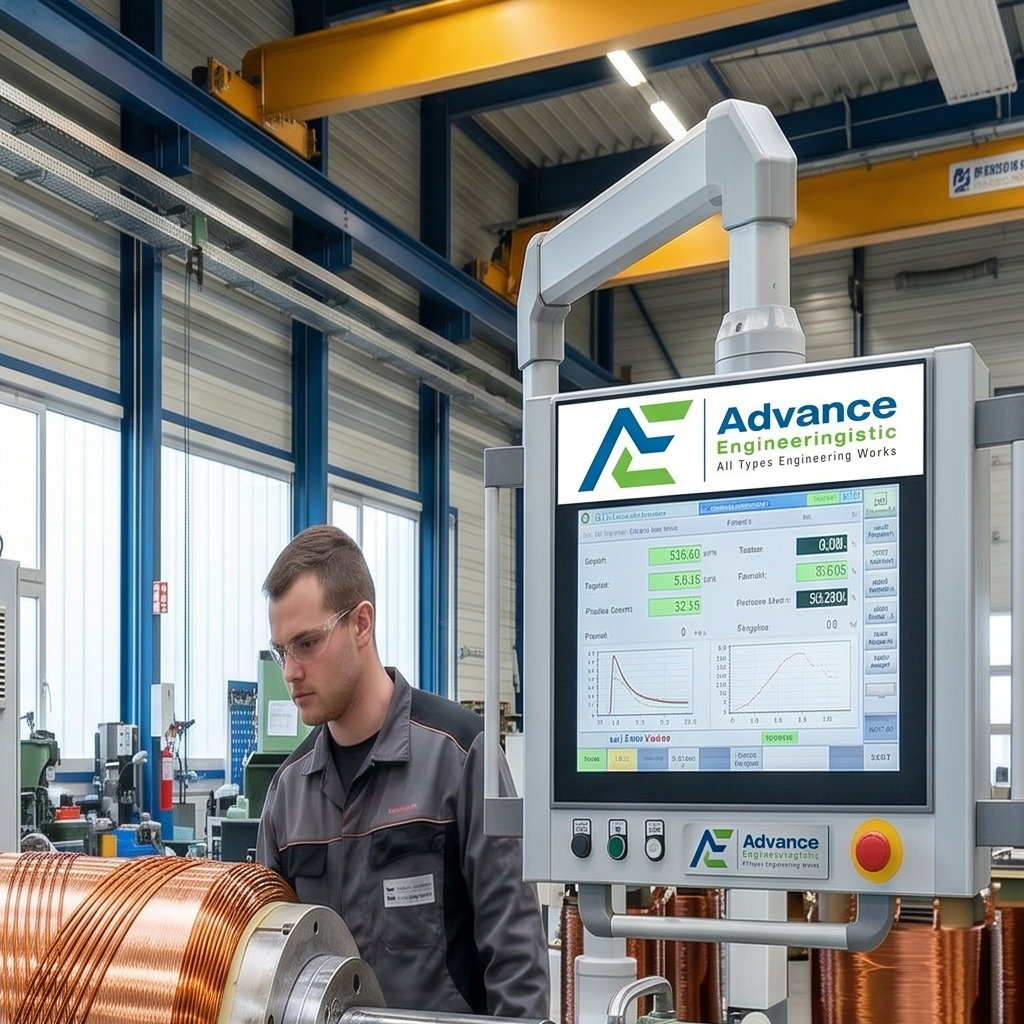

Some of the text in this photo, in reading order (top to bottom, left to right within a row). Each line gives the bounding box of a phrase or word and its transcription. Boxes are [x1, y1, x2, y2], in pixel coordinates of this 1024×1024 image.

[717, 396, 897, 435] Advance
[717, 425, 897, 456] Engineeringistic
[717, 447, 897, 471] All Types Engineering Works
[743, 834, 820, 850] Advance
